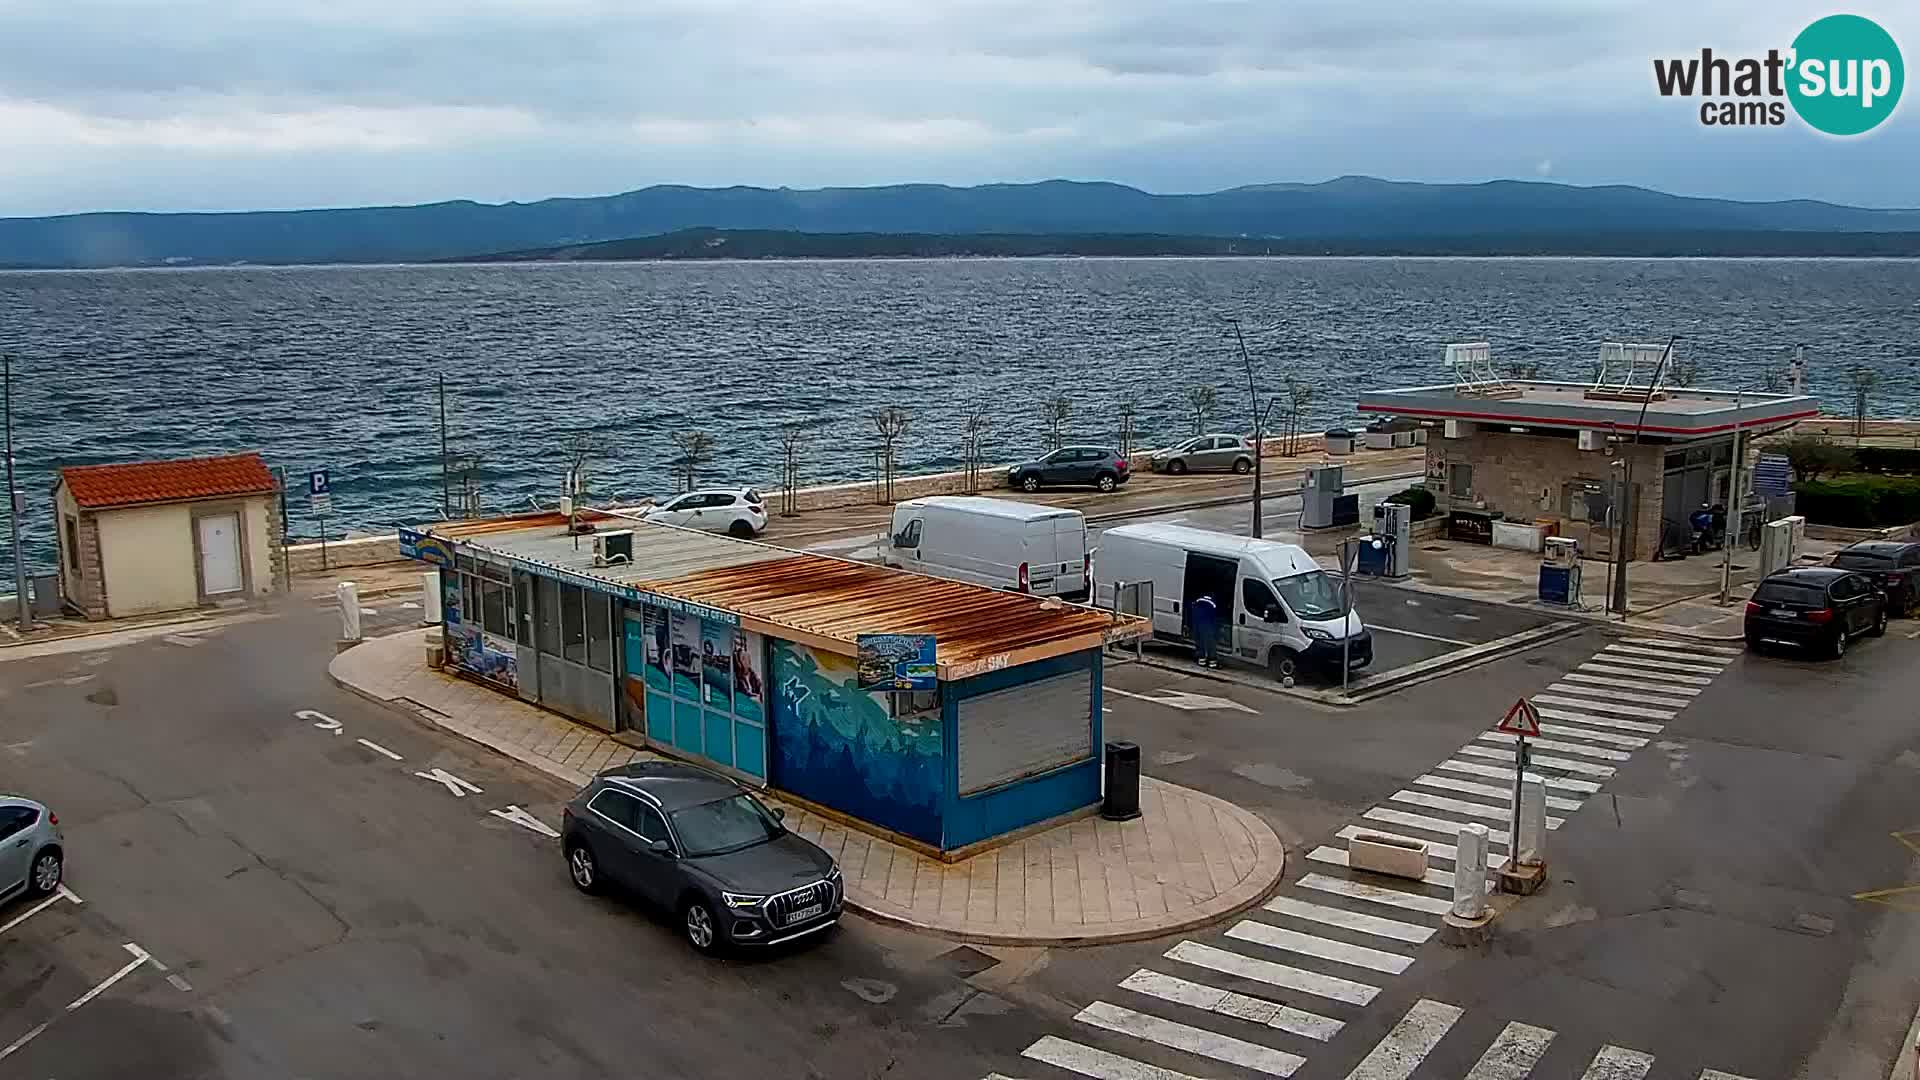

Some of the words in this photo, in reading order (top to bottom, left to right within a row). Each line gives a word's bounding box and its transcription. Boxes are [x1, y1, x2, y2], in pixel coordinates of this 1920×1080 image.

[313, 474, 325, 491] P
[652, 595, 683, 611] STATION
[684, 604, 709, 617] TICKET
[710, 610, 737, 624] OFFICE
